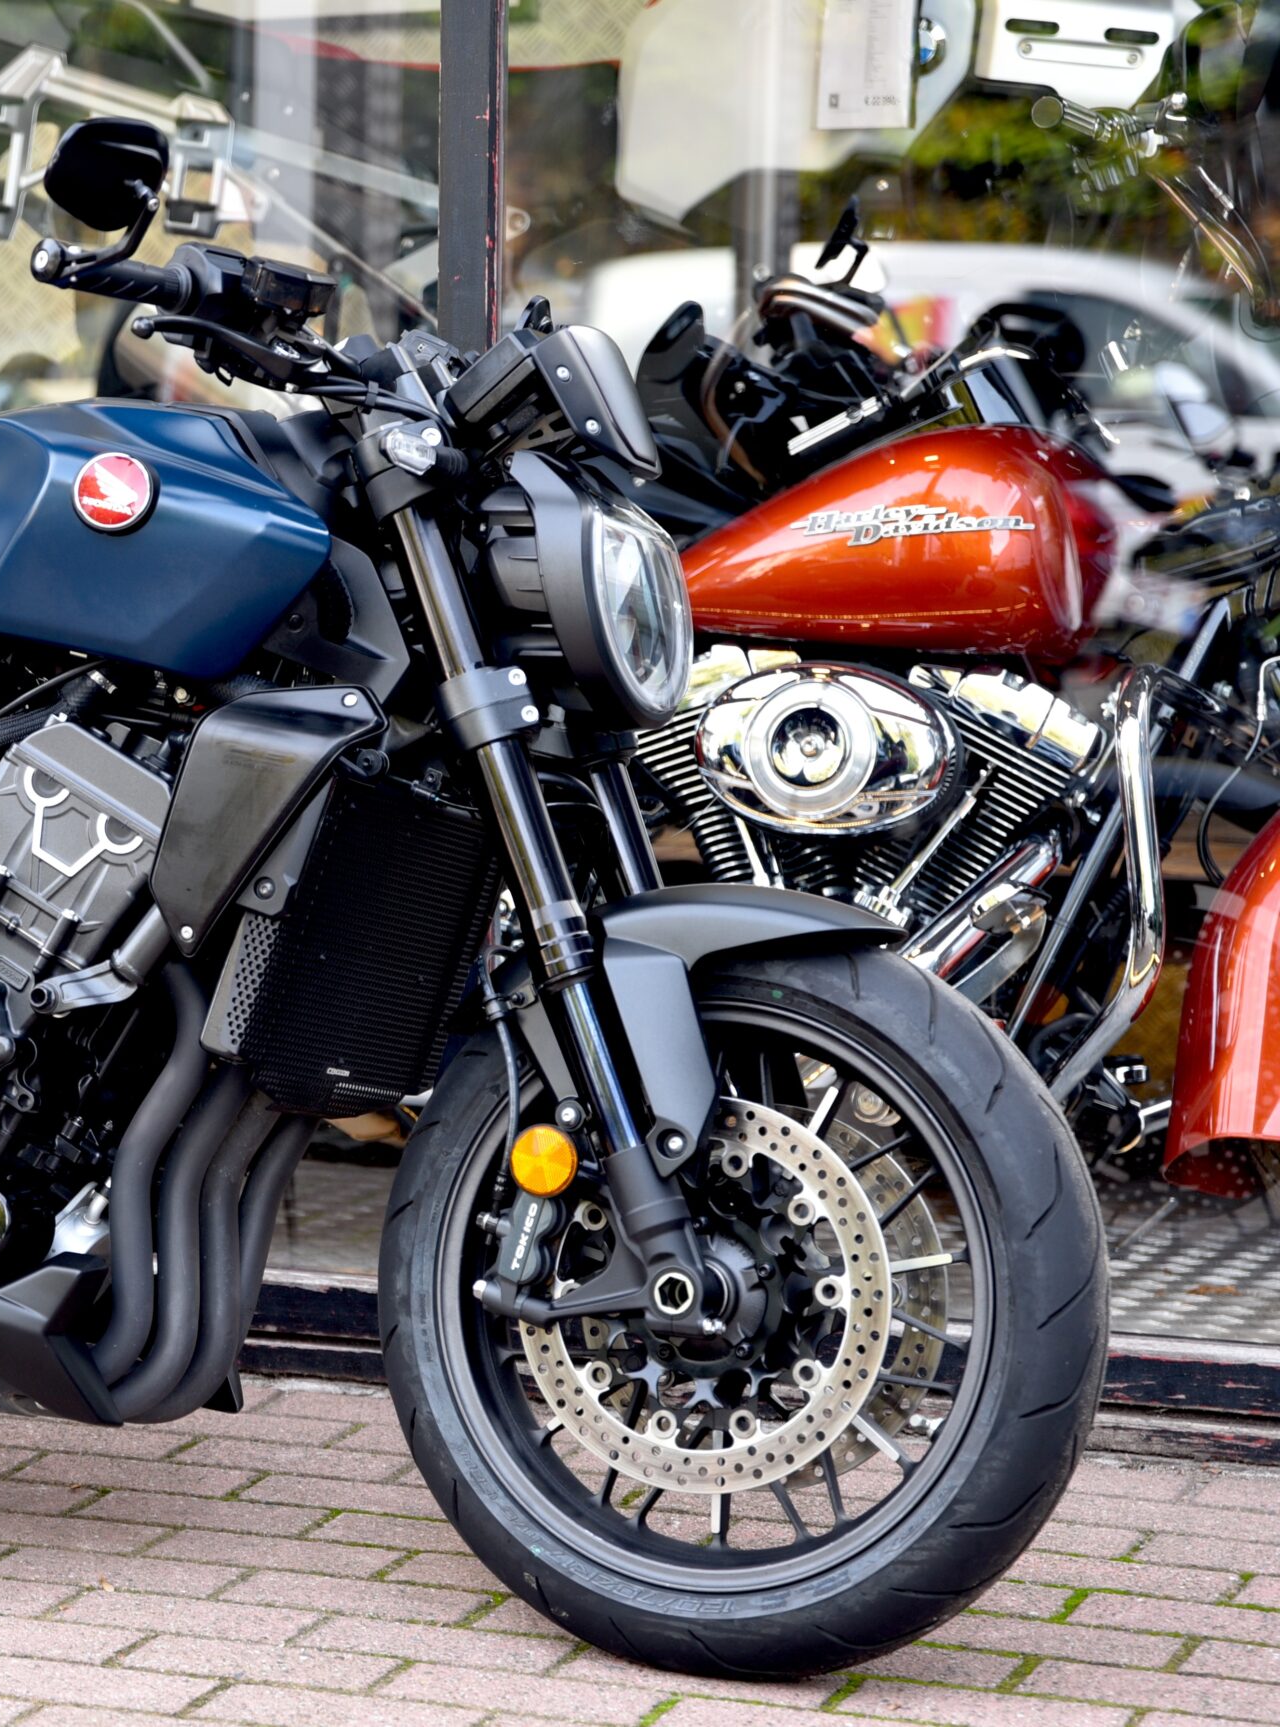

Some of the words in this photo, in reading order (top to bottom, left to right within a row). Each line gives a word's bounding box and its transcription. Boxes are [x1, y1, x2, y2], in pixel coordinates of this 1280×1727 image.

[791, 503, 947, 537] Harley
[847, 512, 1035, 547] Davidson
[510, 1202, 538, 1271] TOKICO
